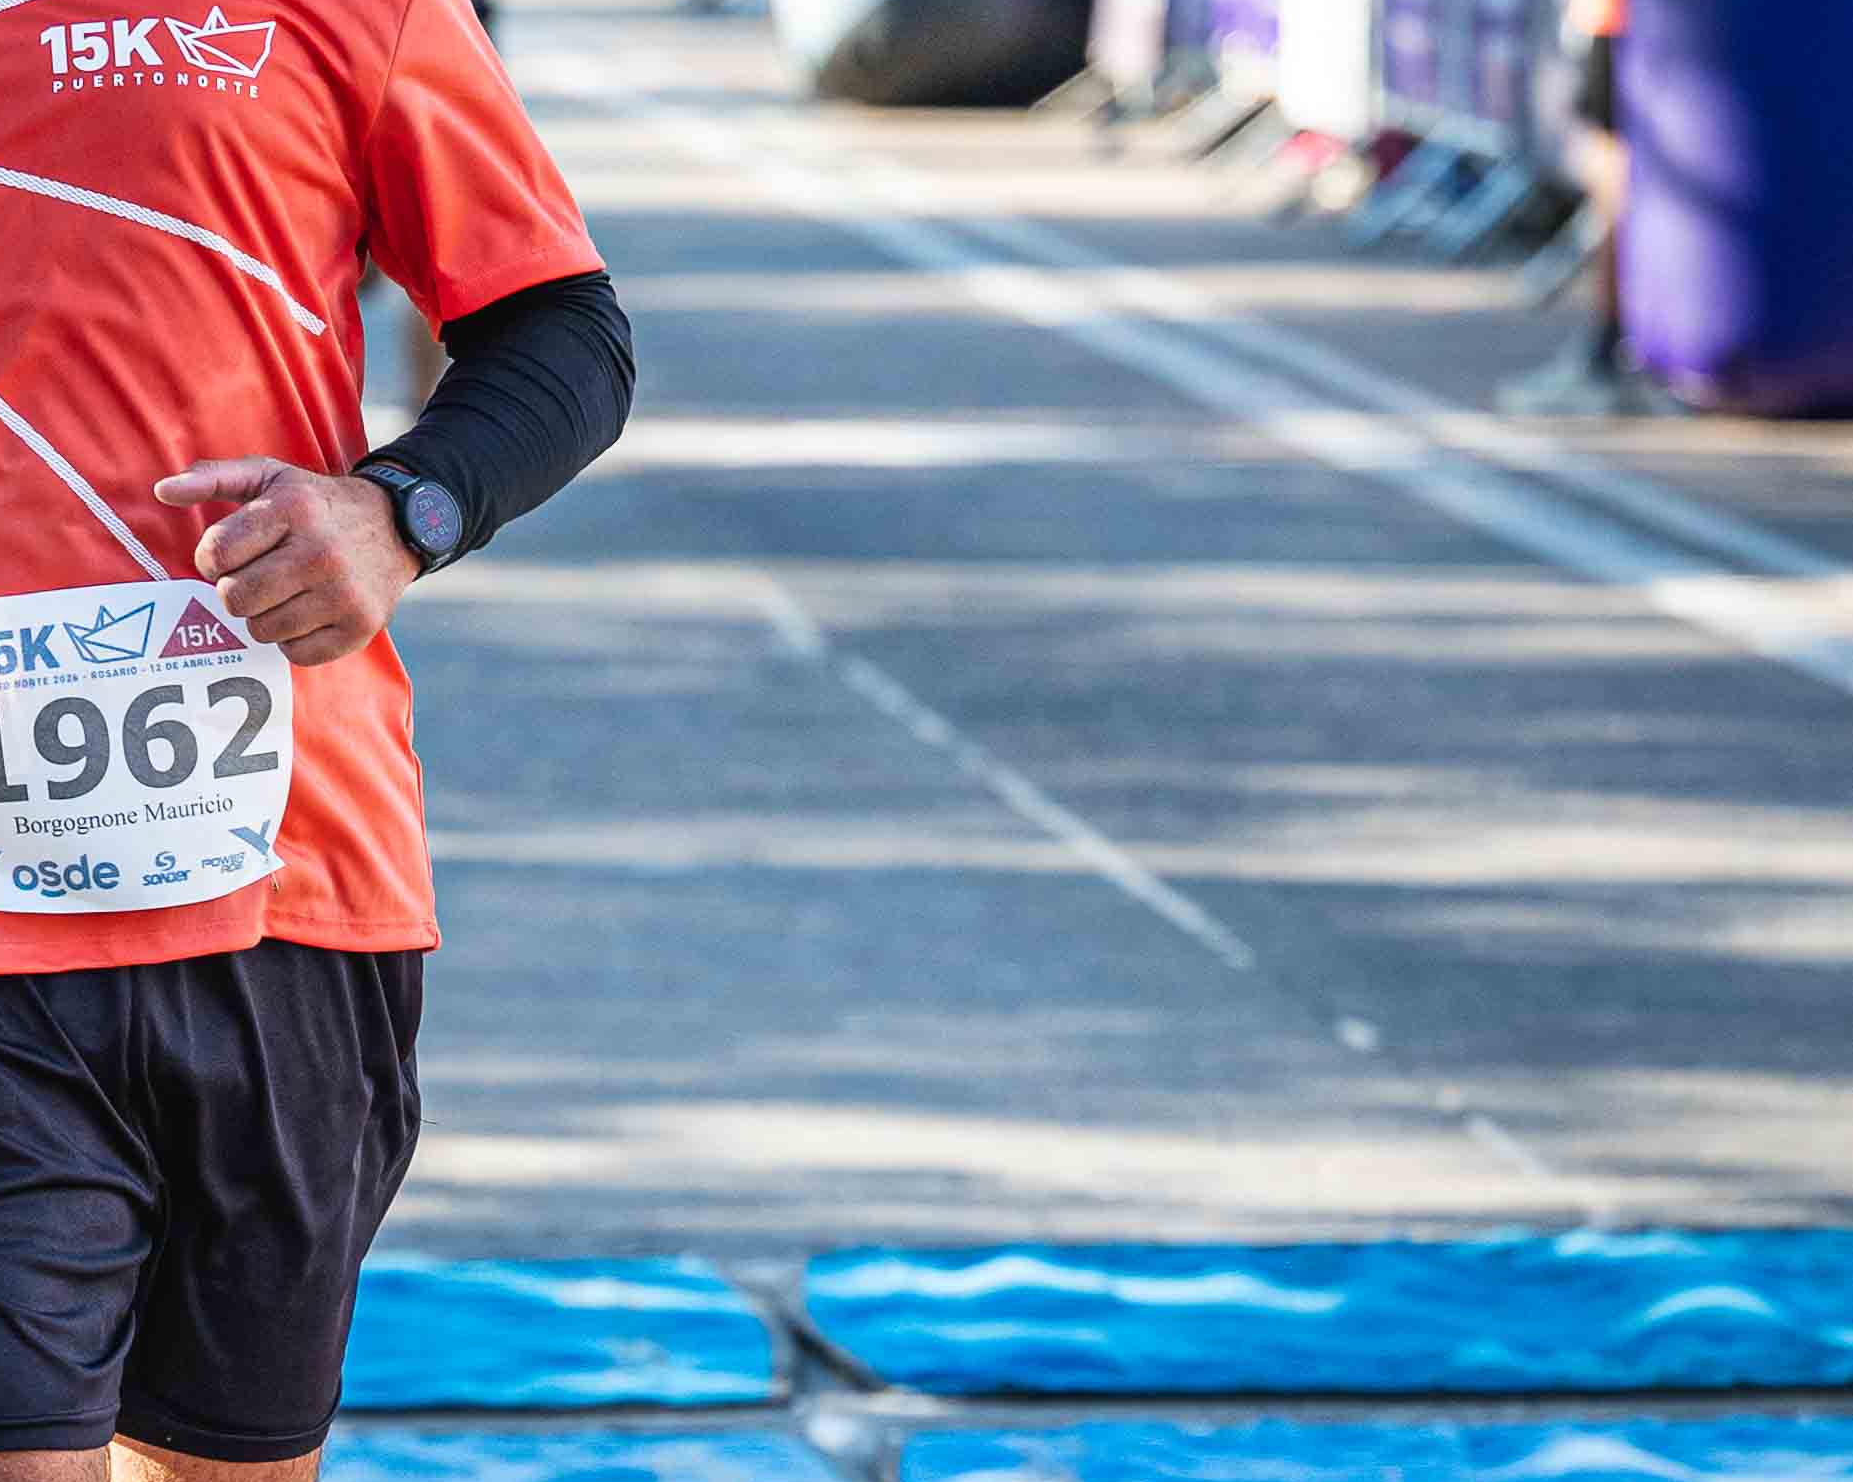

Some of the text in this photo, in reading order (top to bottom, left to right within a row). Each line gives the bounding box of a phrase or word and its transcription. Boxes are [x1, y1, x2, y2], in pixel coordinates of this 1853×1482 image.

[40, 18, 164, 75] 15K
[52, 73, 258, 98] PUERTO NORTE
[176, 623, 225, 649] 15K
[14, 676, 48, 689] NORTE
[53, 674, 79, 684] 2026
[90, 666, 138, 680] ROSARIO
[150, 663, 162, 673] 12
[165, 661, 179, 671] DE
[183, 656, 214, 668] ABRIL
[218, 653, 243, 665] 2026
[14, 794, 234, 838] Borgognone Mauricio
[12, 853, 121, 898] osde
